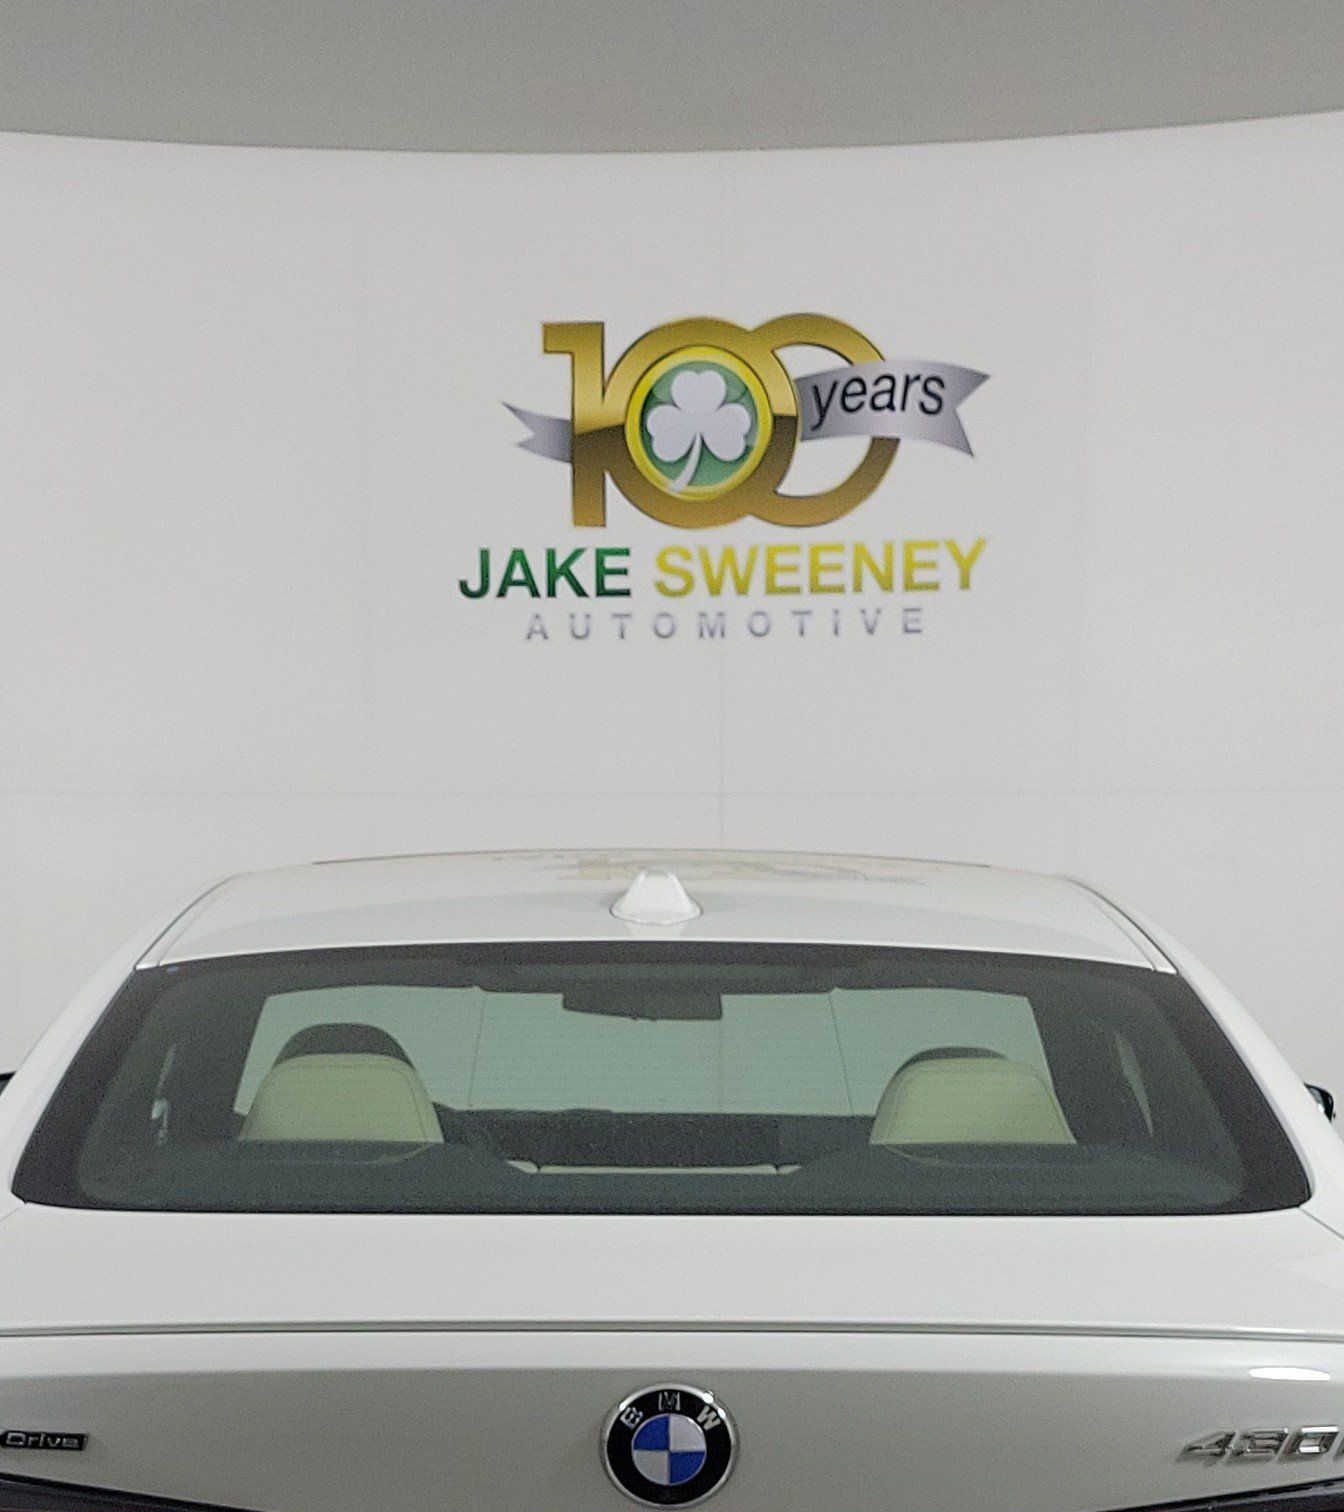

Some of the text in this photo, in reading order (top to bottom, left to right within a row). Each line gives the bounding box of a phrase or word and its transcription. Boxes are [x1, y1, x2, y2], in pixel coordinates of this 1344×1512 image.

[810, 373, 947, 431] years
[459, 537, 988, 600] JAKE SWEENEY
[526, 608, 924, 641] AUTOMOTIVE
[619, 1390, 722, 1431] BMW
